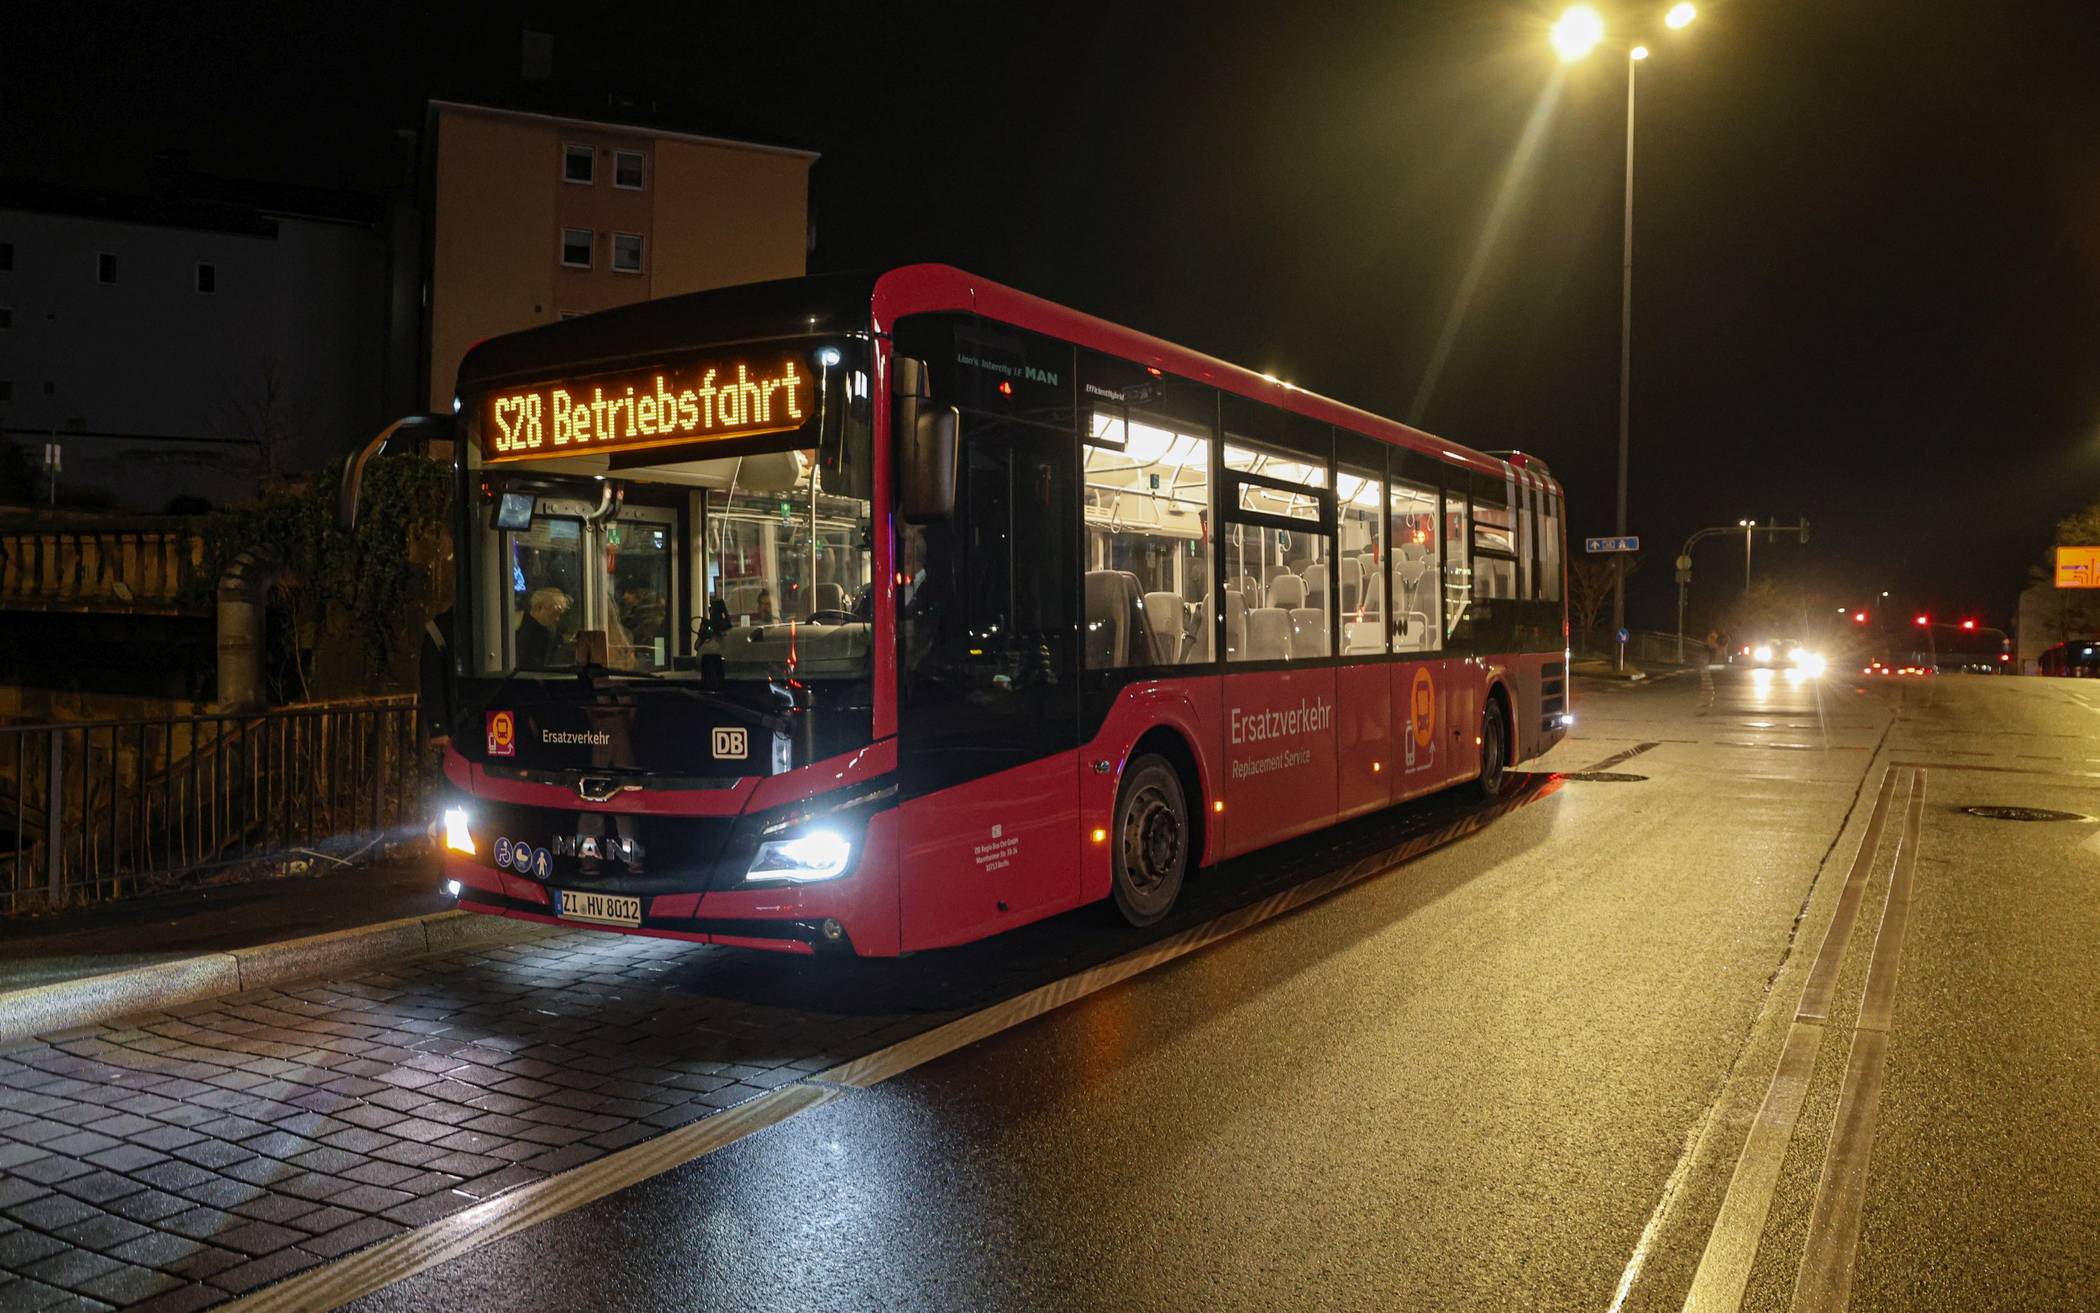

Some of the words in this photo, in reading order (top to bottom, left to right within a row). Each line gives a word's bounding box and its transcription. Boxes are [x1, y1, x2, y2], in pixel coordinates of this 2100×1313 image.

[1024, 366, 1059, 387] MAN
[495, 394, 543, 452] S28
[553, 361, 803, 447] Betriebsfahrt
[1231, 696, 1332, 745] Ersatzverkehr
[542, 729, 610, 745] Ersatzverkehr
[715, 731, 745, 755] DB
[1232, 754, 1284, 782] Replacement
[1284, 749, 1311, 768] Service
[552, 834, 634, 863] MAN
[563, 893, 578, 913] ZI
[587, 896, 603, 916] HV
[607, 898, 640, 920] 8012
